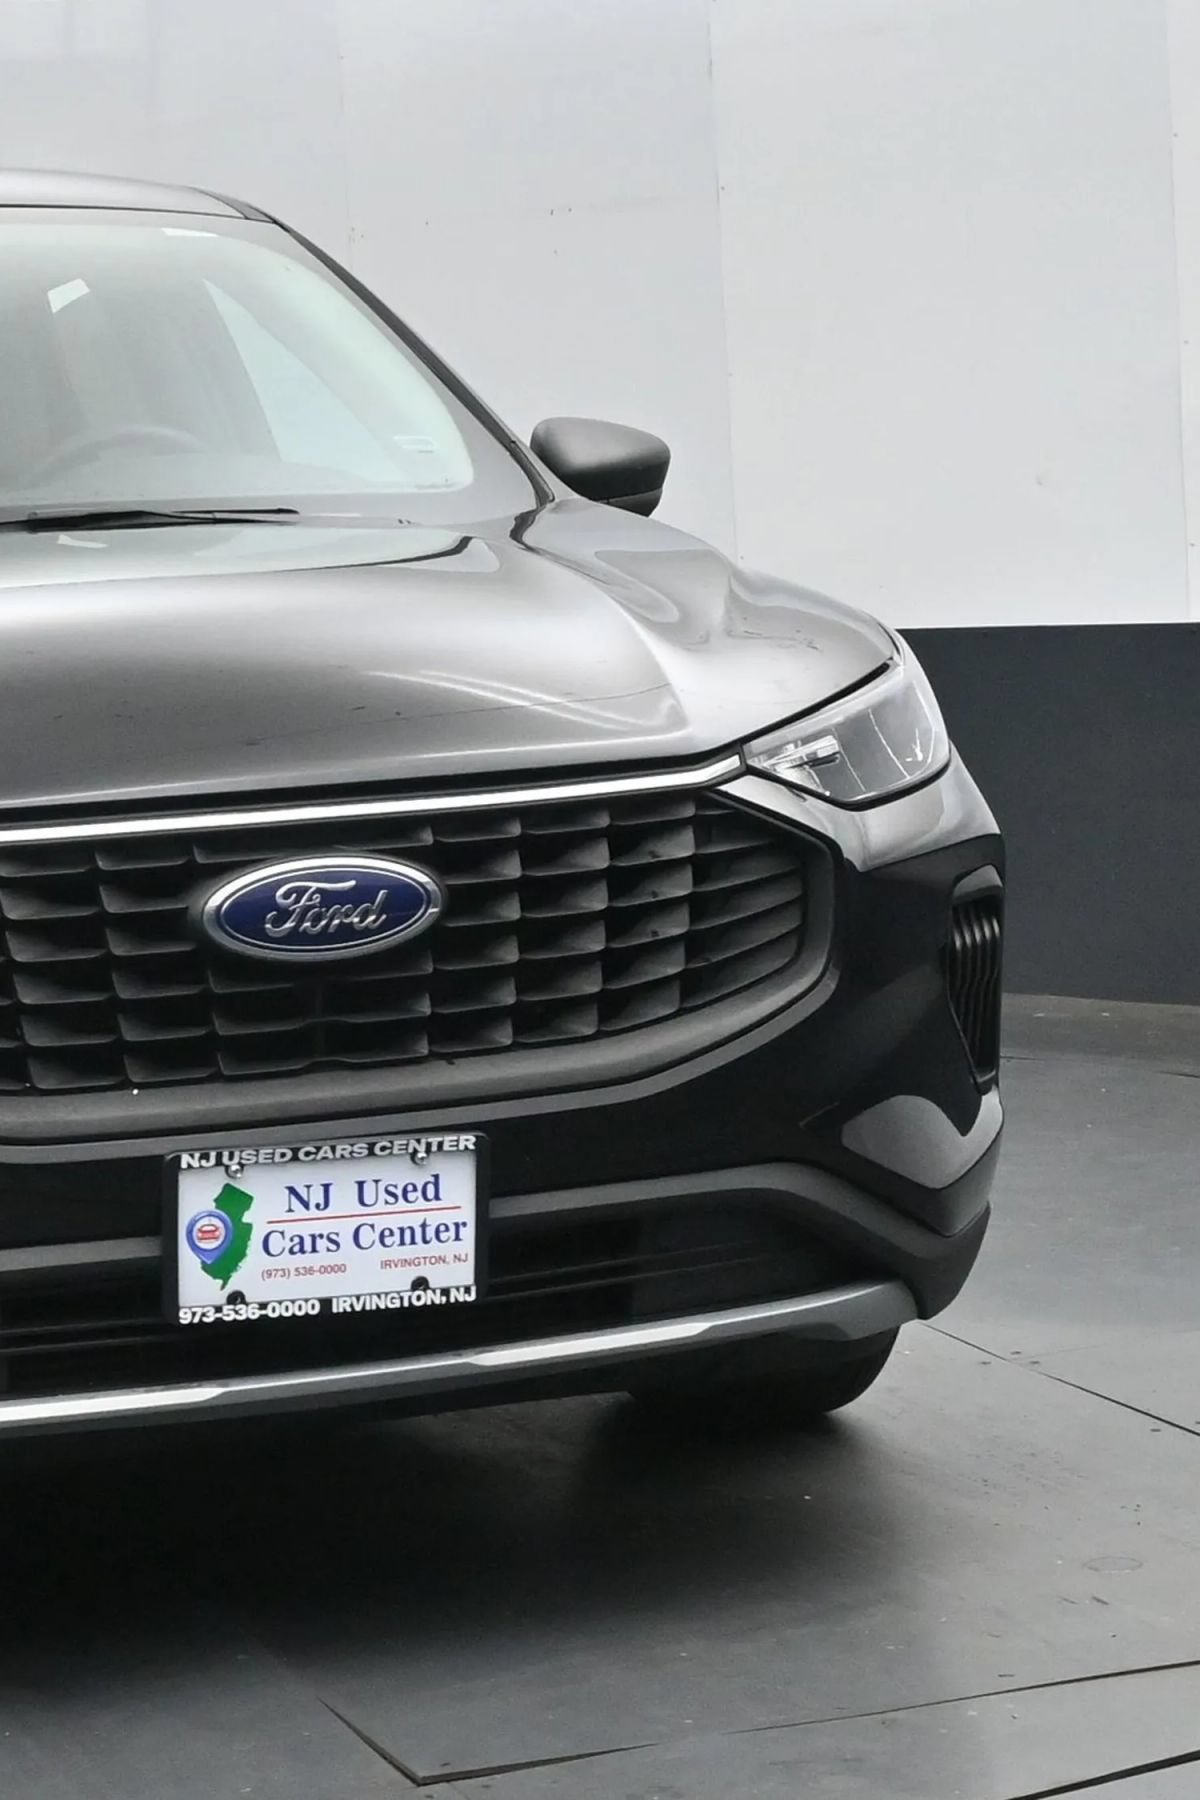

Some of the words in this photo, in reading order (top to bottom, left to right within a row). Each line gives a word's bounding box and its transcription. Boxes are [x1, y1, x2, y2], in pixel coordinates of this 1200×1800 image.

[265, 880, 388, 938] Ford
[180, 1151, 218, 1169] NJ
[222, 1146, 292, 1167] USED
[298, 1141, 370, 1161] CARS
[373, 1135, 476, 1156] CENTER
[284, 1183, 334, 1213] NJ
[354, 1173, 442, 1208] Used
[262, 1228, 341, 1258] Cars
[352, 1217, 468, 1251] Center
[261, 1266, 291, 1281] (973)
[294, 1263, 347, 1277] 536-0000
[380, 1255, 450, 1271] IRVINGTON,
[453, 1253, 469, 1265] NJ
[179, 1298, 320, 1325] 973-536-0000
[331, 1288, 447, 1314] IRVINGTON,
[449, 1286, 477, 1303] NJ
